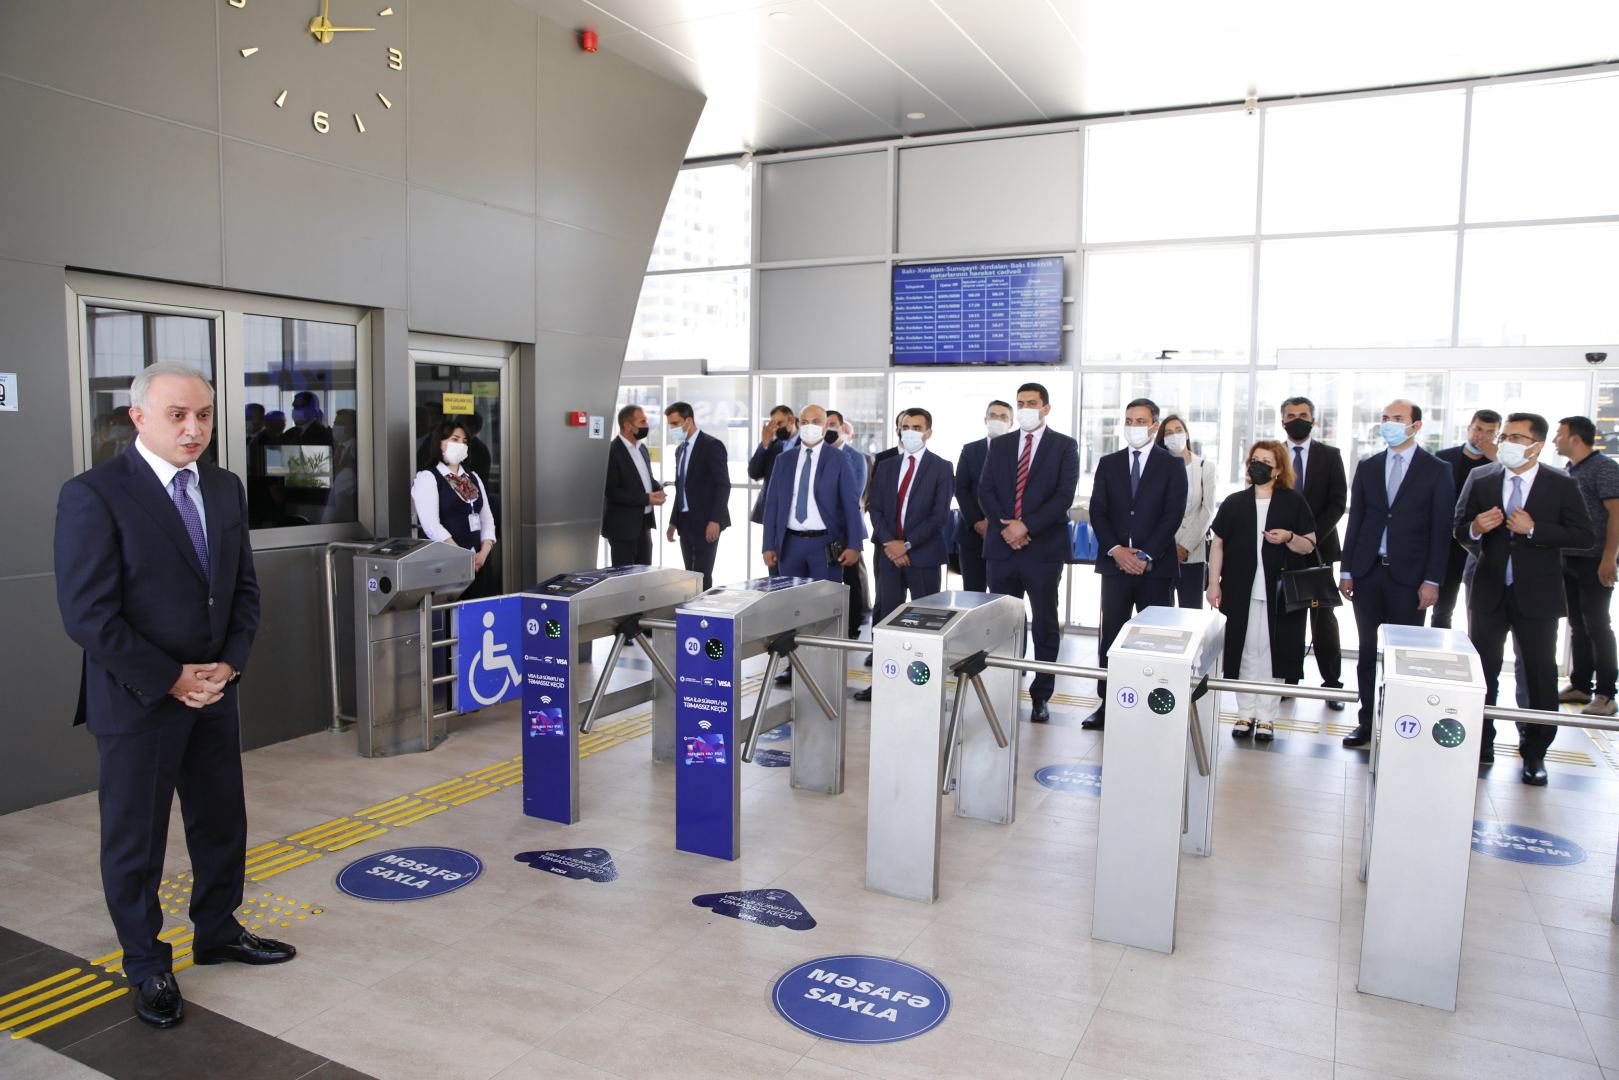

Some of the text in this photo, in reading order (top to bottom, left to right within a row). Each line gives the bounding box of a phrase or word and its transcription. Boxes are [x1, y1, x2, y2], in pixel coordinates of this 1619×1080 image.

[388, 47, 402, 70] 3
[314, 111, 329, 133] 6
[369, 581, 377, 589] 22
[529, 623, 537, 631] 21
[688, 642, 698, 651] 20
[885, 664, 897, 674] 19
[1121, 692, 1134, 703] 18
[1400, 721, 1417, 733] 17
[380, 854, 462, 881] MƏSAFƏ
[365, 866, 430, 889] SAXLA
[807, 968, 930, 1008] MƏSAFƏ
[803, 987, 898, 1022] SAXLA
